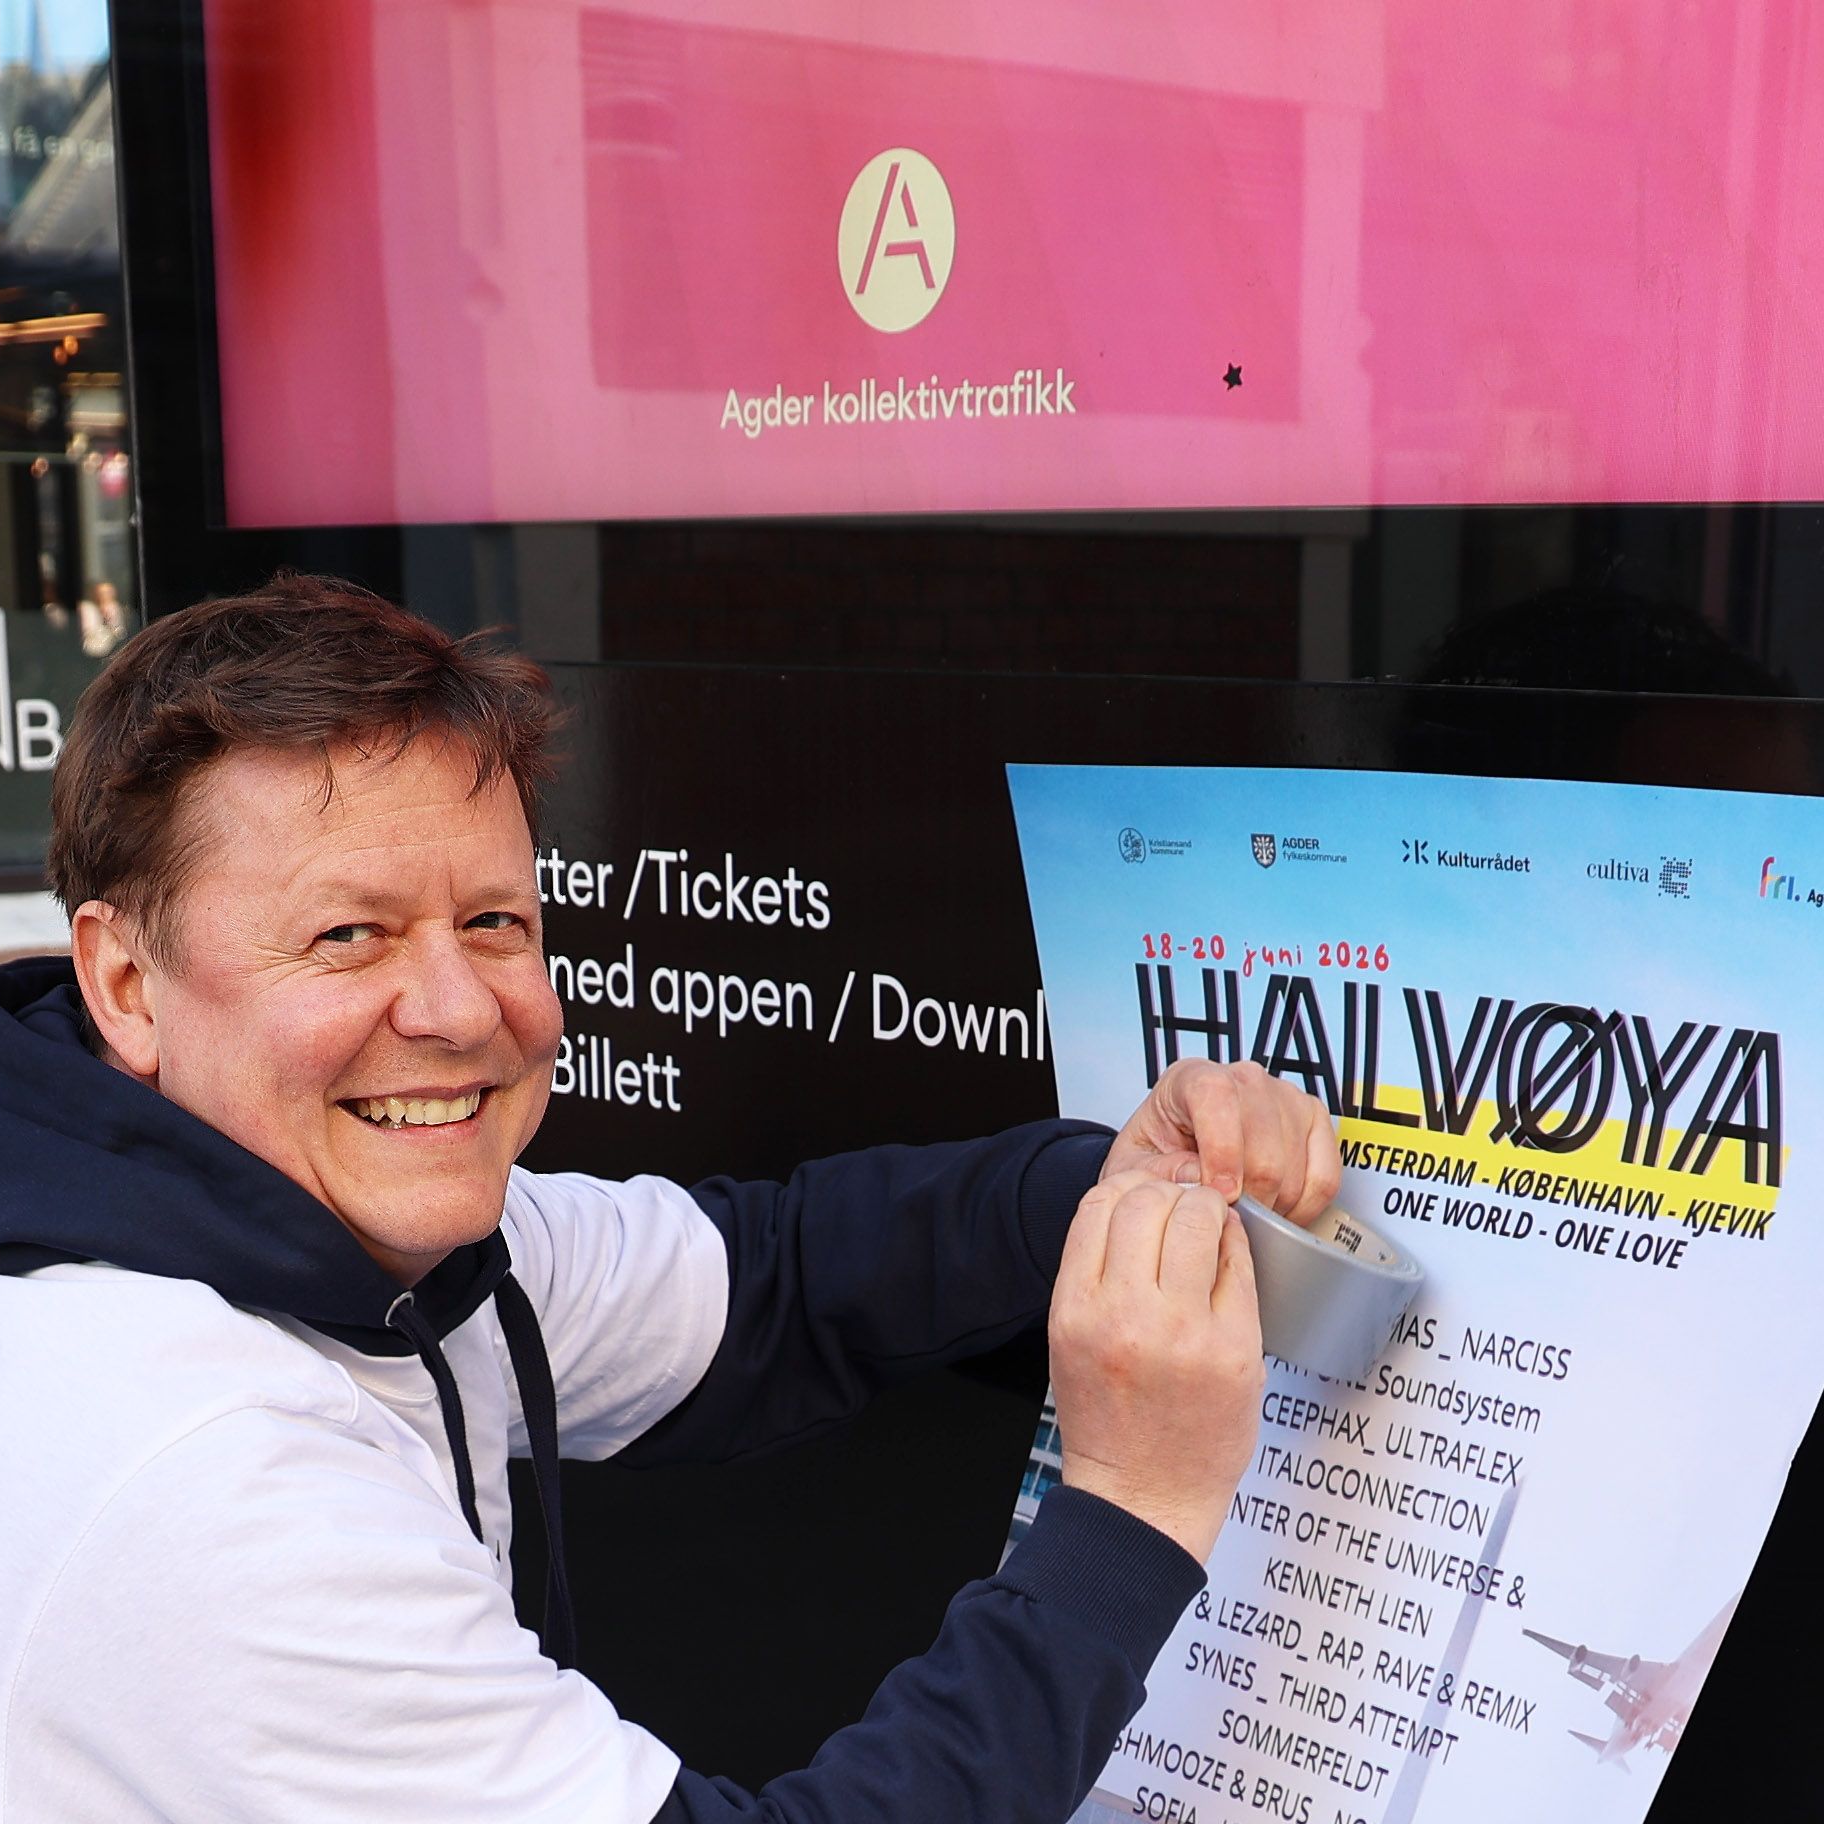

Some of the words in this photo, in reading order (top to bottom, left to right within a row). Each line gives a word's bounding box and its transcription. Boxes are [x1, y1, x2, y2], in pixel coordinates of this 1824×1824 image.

[721, 388, 814, 440] Agder
[823, 368, 1077, 425] kollektivtrafikk
[1281, 837, 1320, 850] AGDER
[1282, 849, 1348, 864] fylkeskommune
[1437, 849, 1531, 873] Kulturrådet
[1586, 858, 1649, 883] cultiva
[1142, 932, 1225, 961] 18-20
[1242, 941, 1302, 977] juni
[1318, 941, 1390, 972] 2026
[650, 970, 813, 1038] appen
[552, 1034, 682, 1112] Billett
[1135, 961, 1789, 1187] HALVØYA
[1382, 1187, 1441, 1223] ONE
[1442, 1198, 1534, 1244] WORLD
[1553, 1218, 1614, 1256] ONE
[1618, 1230, 1688, 1270] LOVE
[1495, 1166, 1665, 1222] KØBENHAVN
[1682, 1198, 1776, 1241] KJEVIK
[1460, 1326, 1572, 1381] NARCISS
[1373, 1360, 1541, 1433] Soundsystem
[1257, 1444, 1490, 1538] ITALOCONNECTION
[1385, 1422, 1524, 1489] ULTRAFLEX
[1230, 1491, 1291, 1537] NTER
[1295, 1511, 1331, 1546] OF
[1335, 1521, 1382, 1564] THE
[1385, 1537, 1505, 1602] UNIVERSE
[1506, 1575, 1526, 1610] &
[1263, 1556, 1375, 1619] KENNETH
[1377, 1593, 1433, 1638] LIEN
[1194, 1586, 1212, 1623] &
[1316, 1630, 1365, 1679] RAP,
[1373, 1649, 1435, 1698] RAVE
[1436, 1672, 1456, 1707] &
[1460, 1680, 1537, 1734] REMIX
[1185, 1641, 1257, 1692] SYNES
[1279, 1672, 1347, 1724] THIRD
[1348, 1701, 1459, 1764] ATTEMPT
[1112, 1727, 1228, 1794] SHMOOZE
[1229, 1768, 1246, 1802] &
[1218, 1708, 1390, 1797] SOMMERFELDT
